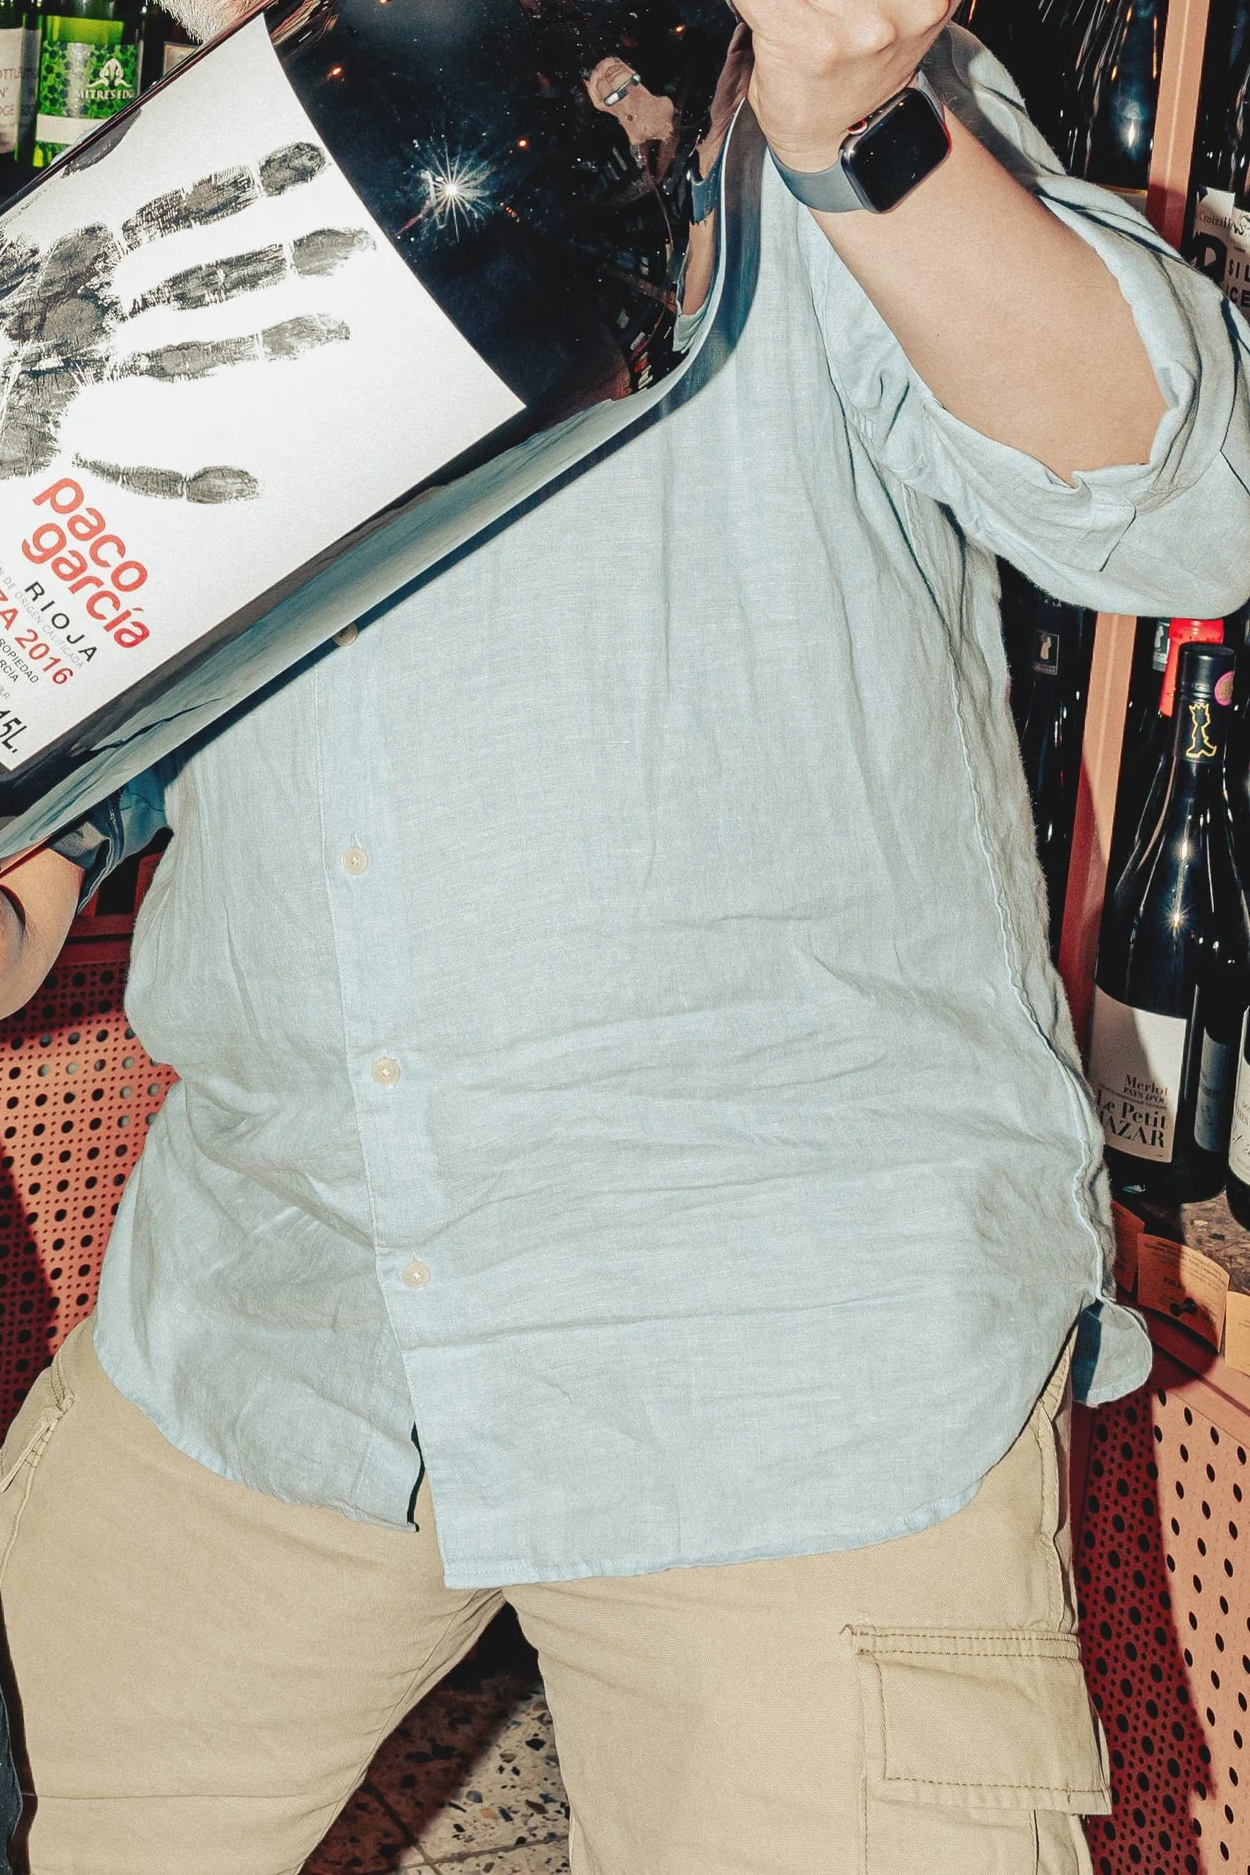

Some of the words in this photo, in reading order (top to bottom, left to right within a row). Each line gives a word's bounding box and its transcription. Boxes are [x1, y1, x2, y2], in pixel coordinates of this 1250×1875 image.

[32, 477, 148, 593] paco
[21, 522, 150, 649] garcía
[2, 576, 16, 590] DE
[14, 590, 43, 626] ORIGEN
[43, 625, 84, 669] CALIFICADA
[24, 581, 97, 662] RIOJA
[14, 628, 73, 685] 2016
[1121, 1101, 1166, 1129] Petit
[1123, 1087, 1145, 1101] PAYS
[1126, 1074, 1169, 1097] Merlot
